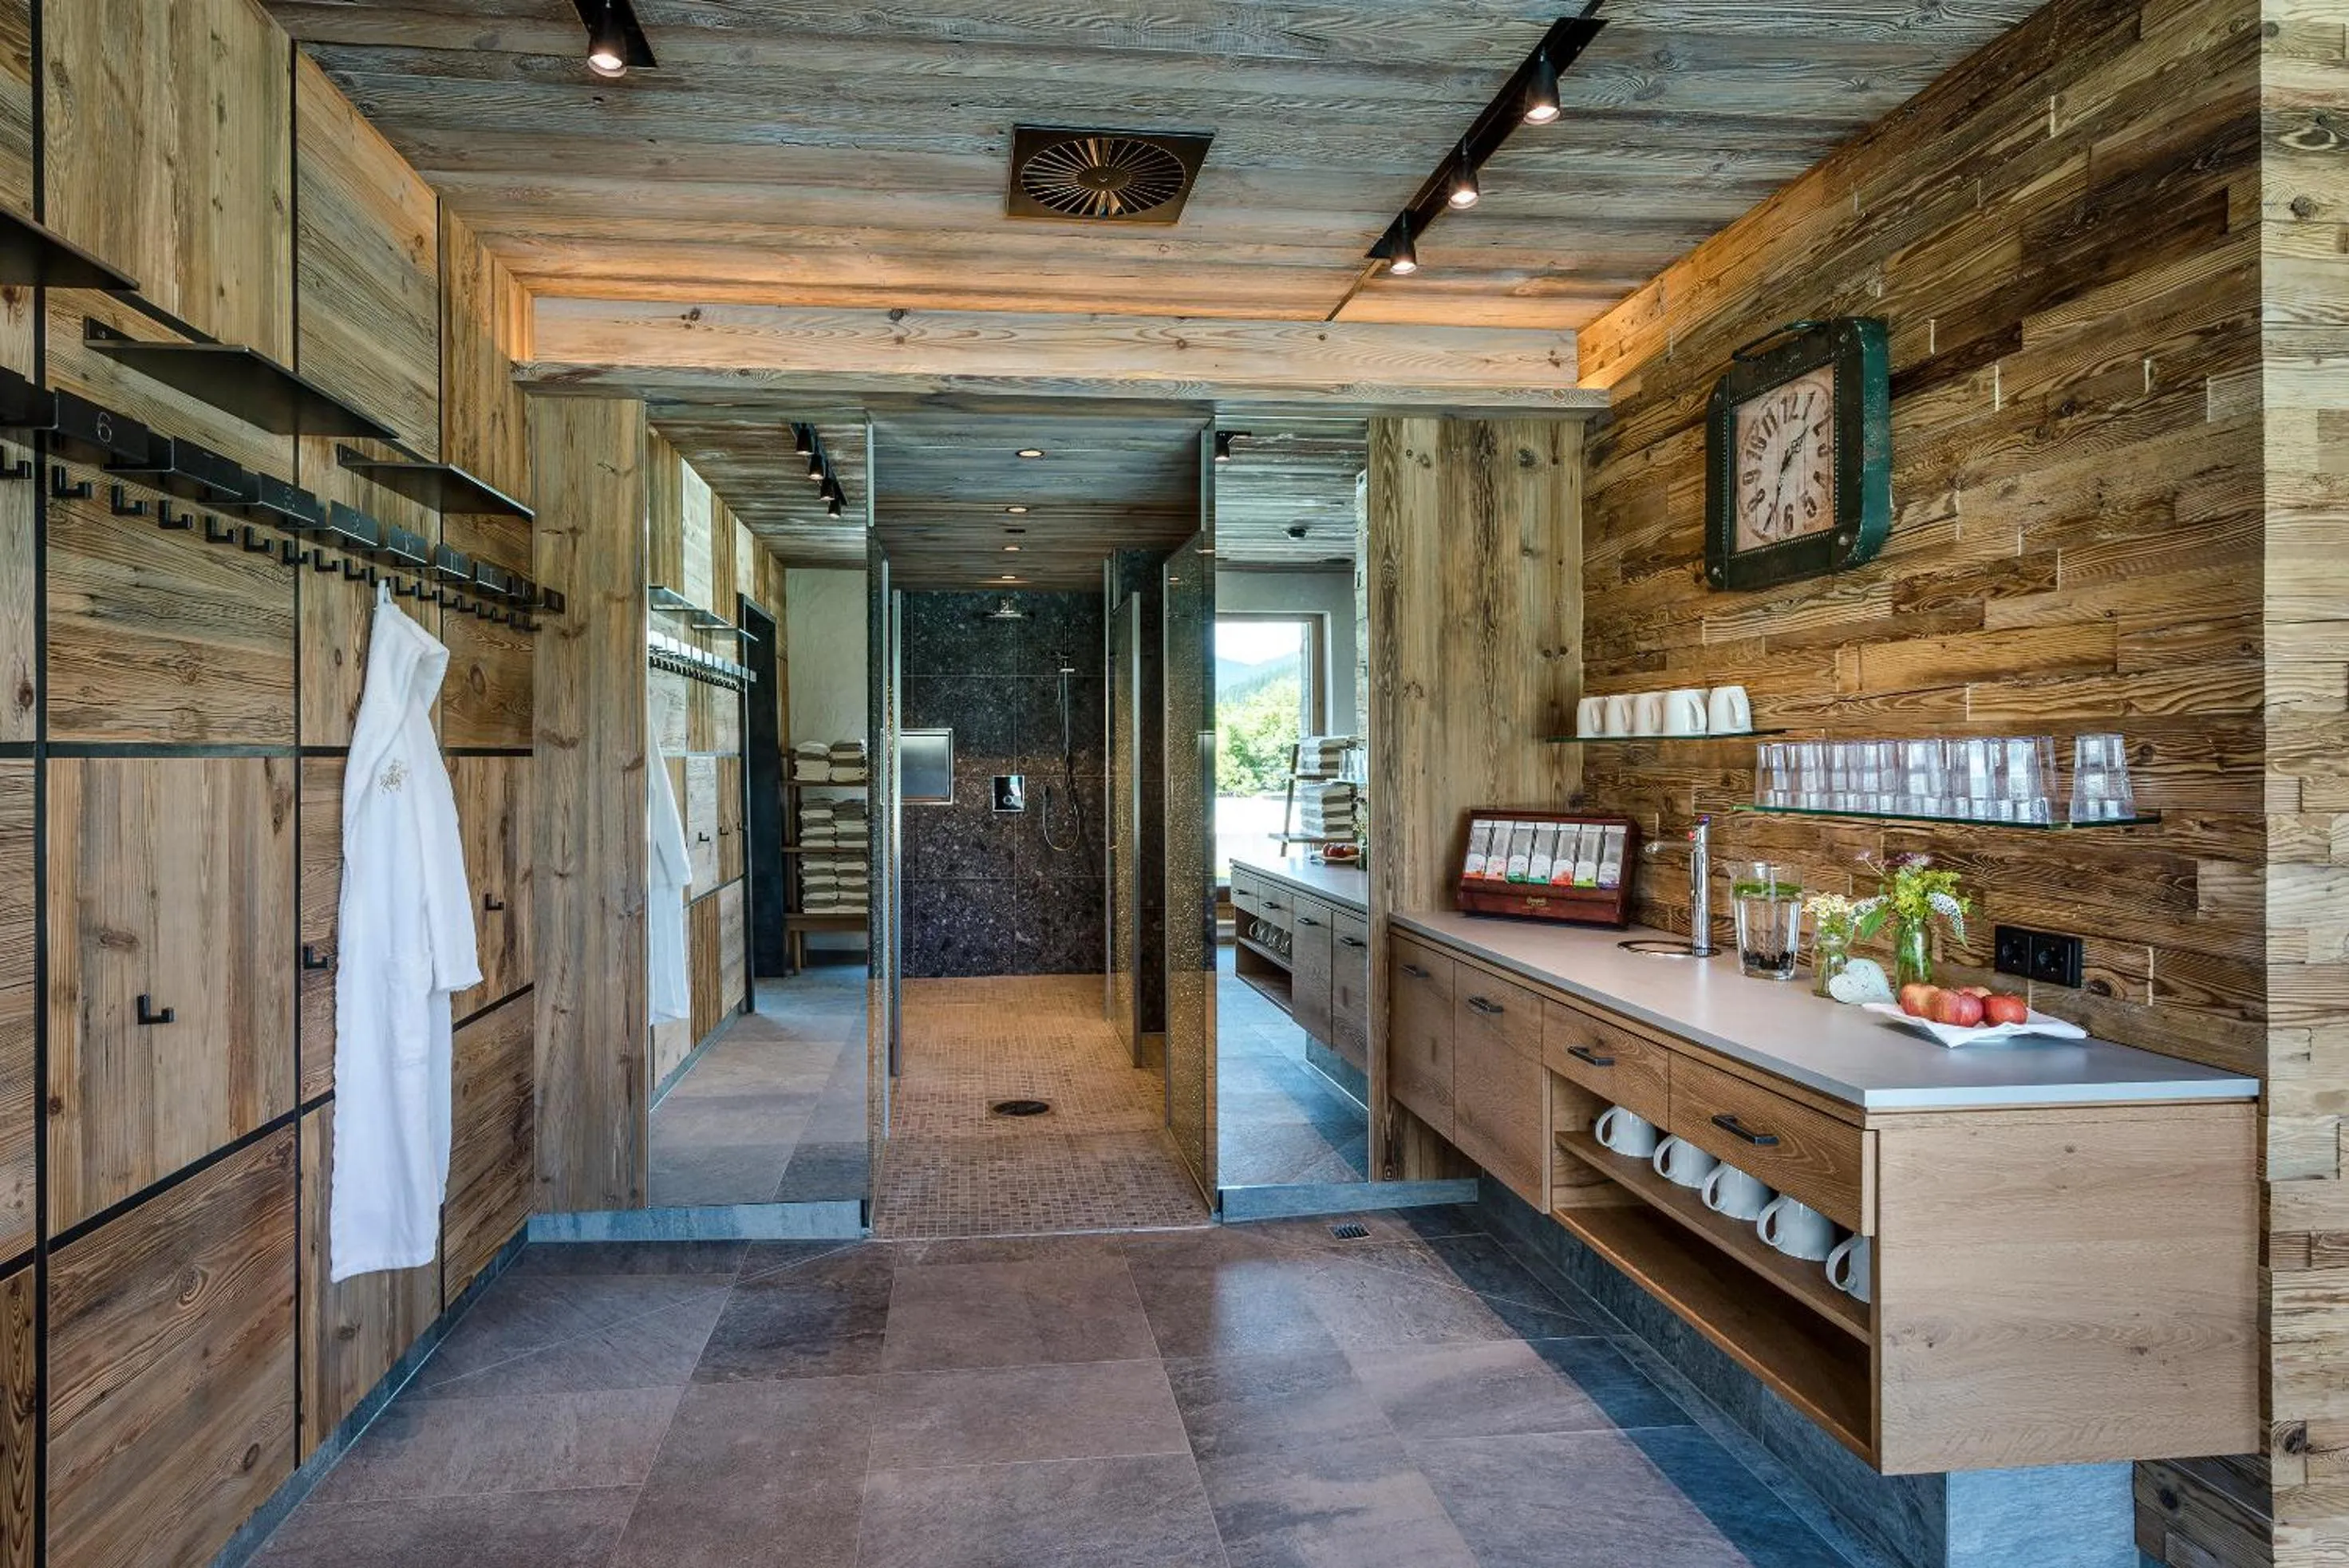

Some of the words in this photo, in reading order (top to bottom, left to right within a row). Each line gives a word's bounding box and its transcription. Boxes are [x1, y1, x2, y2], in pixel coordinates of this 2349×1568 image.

[1780, 392, 1798, 425] 12
[1802, 390, 1817, 421] 1
[97, 411, 112, 443] 6
[1761, 405, 1779, 438] 11
[1813, 406, 1832, 437] 2
[1746, 433, 1768, 462] 10
[1818, 444, 1834, 458] 3
[1742, 469, 1761, 486] 9
[1813, 471, 1830, 489] 4
[1747, 488, 1765, 512] 8
[1801, 490, 1817, 519] 5
[1763, 502, 1777, 532] 7
[1783, 504, 1794, 534] 6
